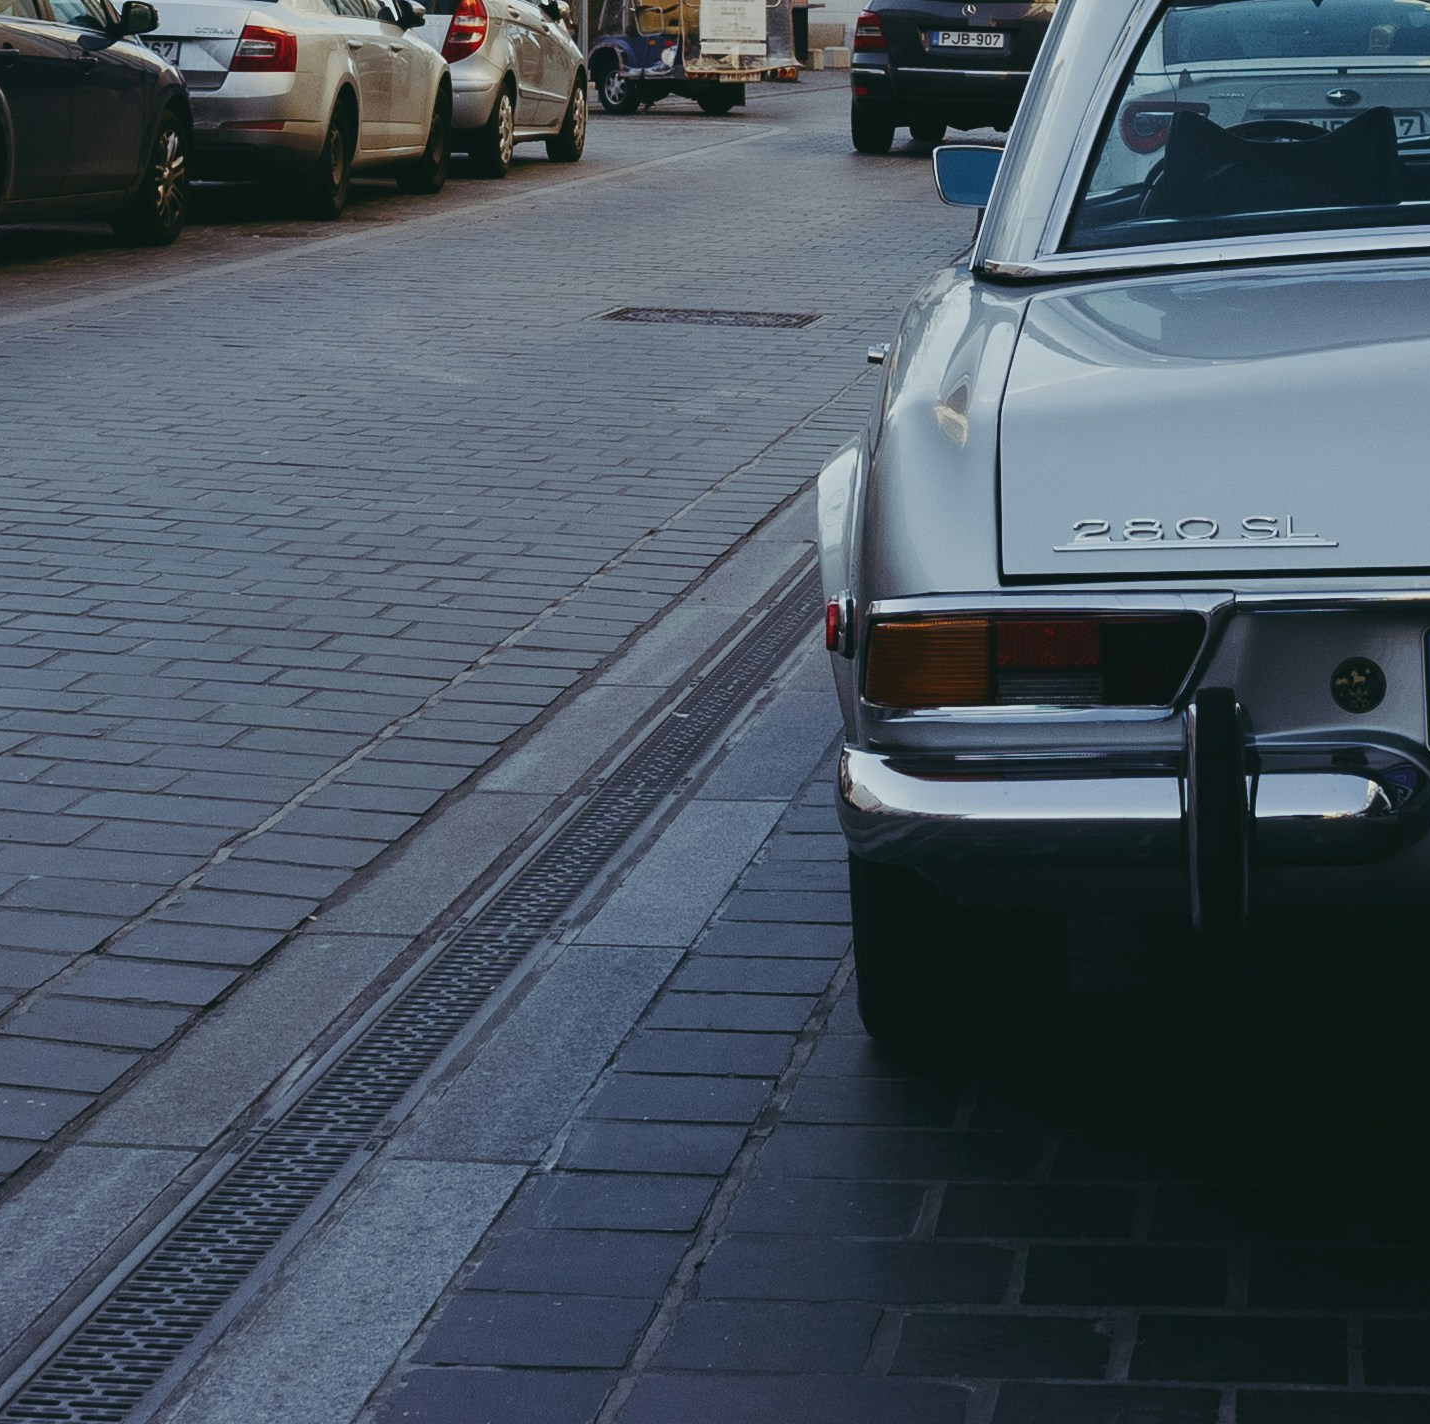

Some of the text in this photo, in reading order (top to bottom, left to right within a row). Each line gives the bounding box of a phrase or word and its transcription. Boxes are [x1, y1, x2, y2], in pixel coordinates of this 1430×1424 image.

[941, 32, 1001, 47] PJB-907
[1073, 514, 1320, 543] 280 SL
